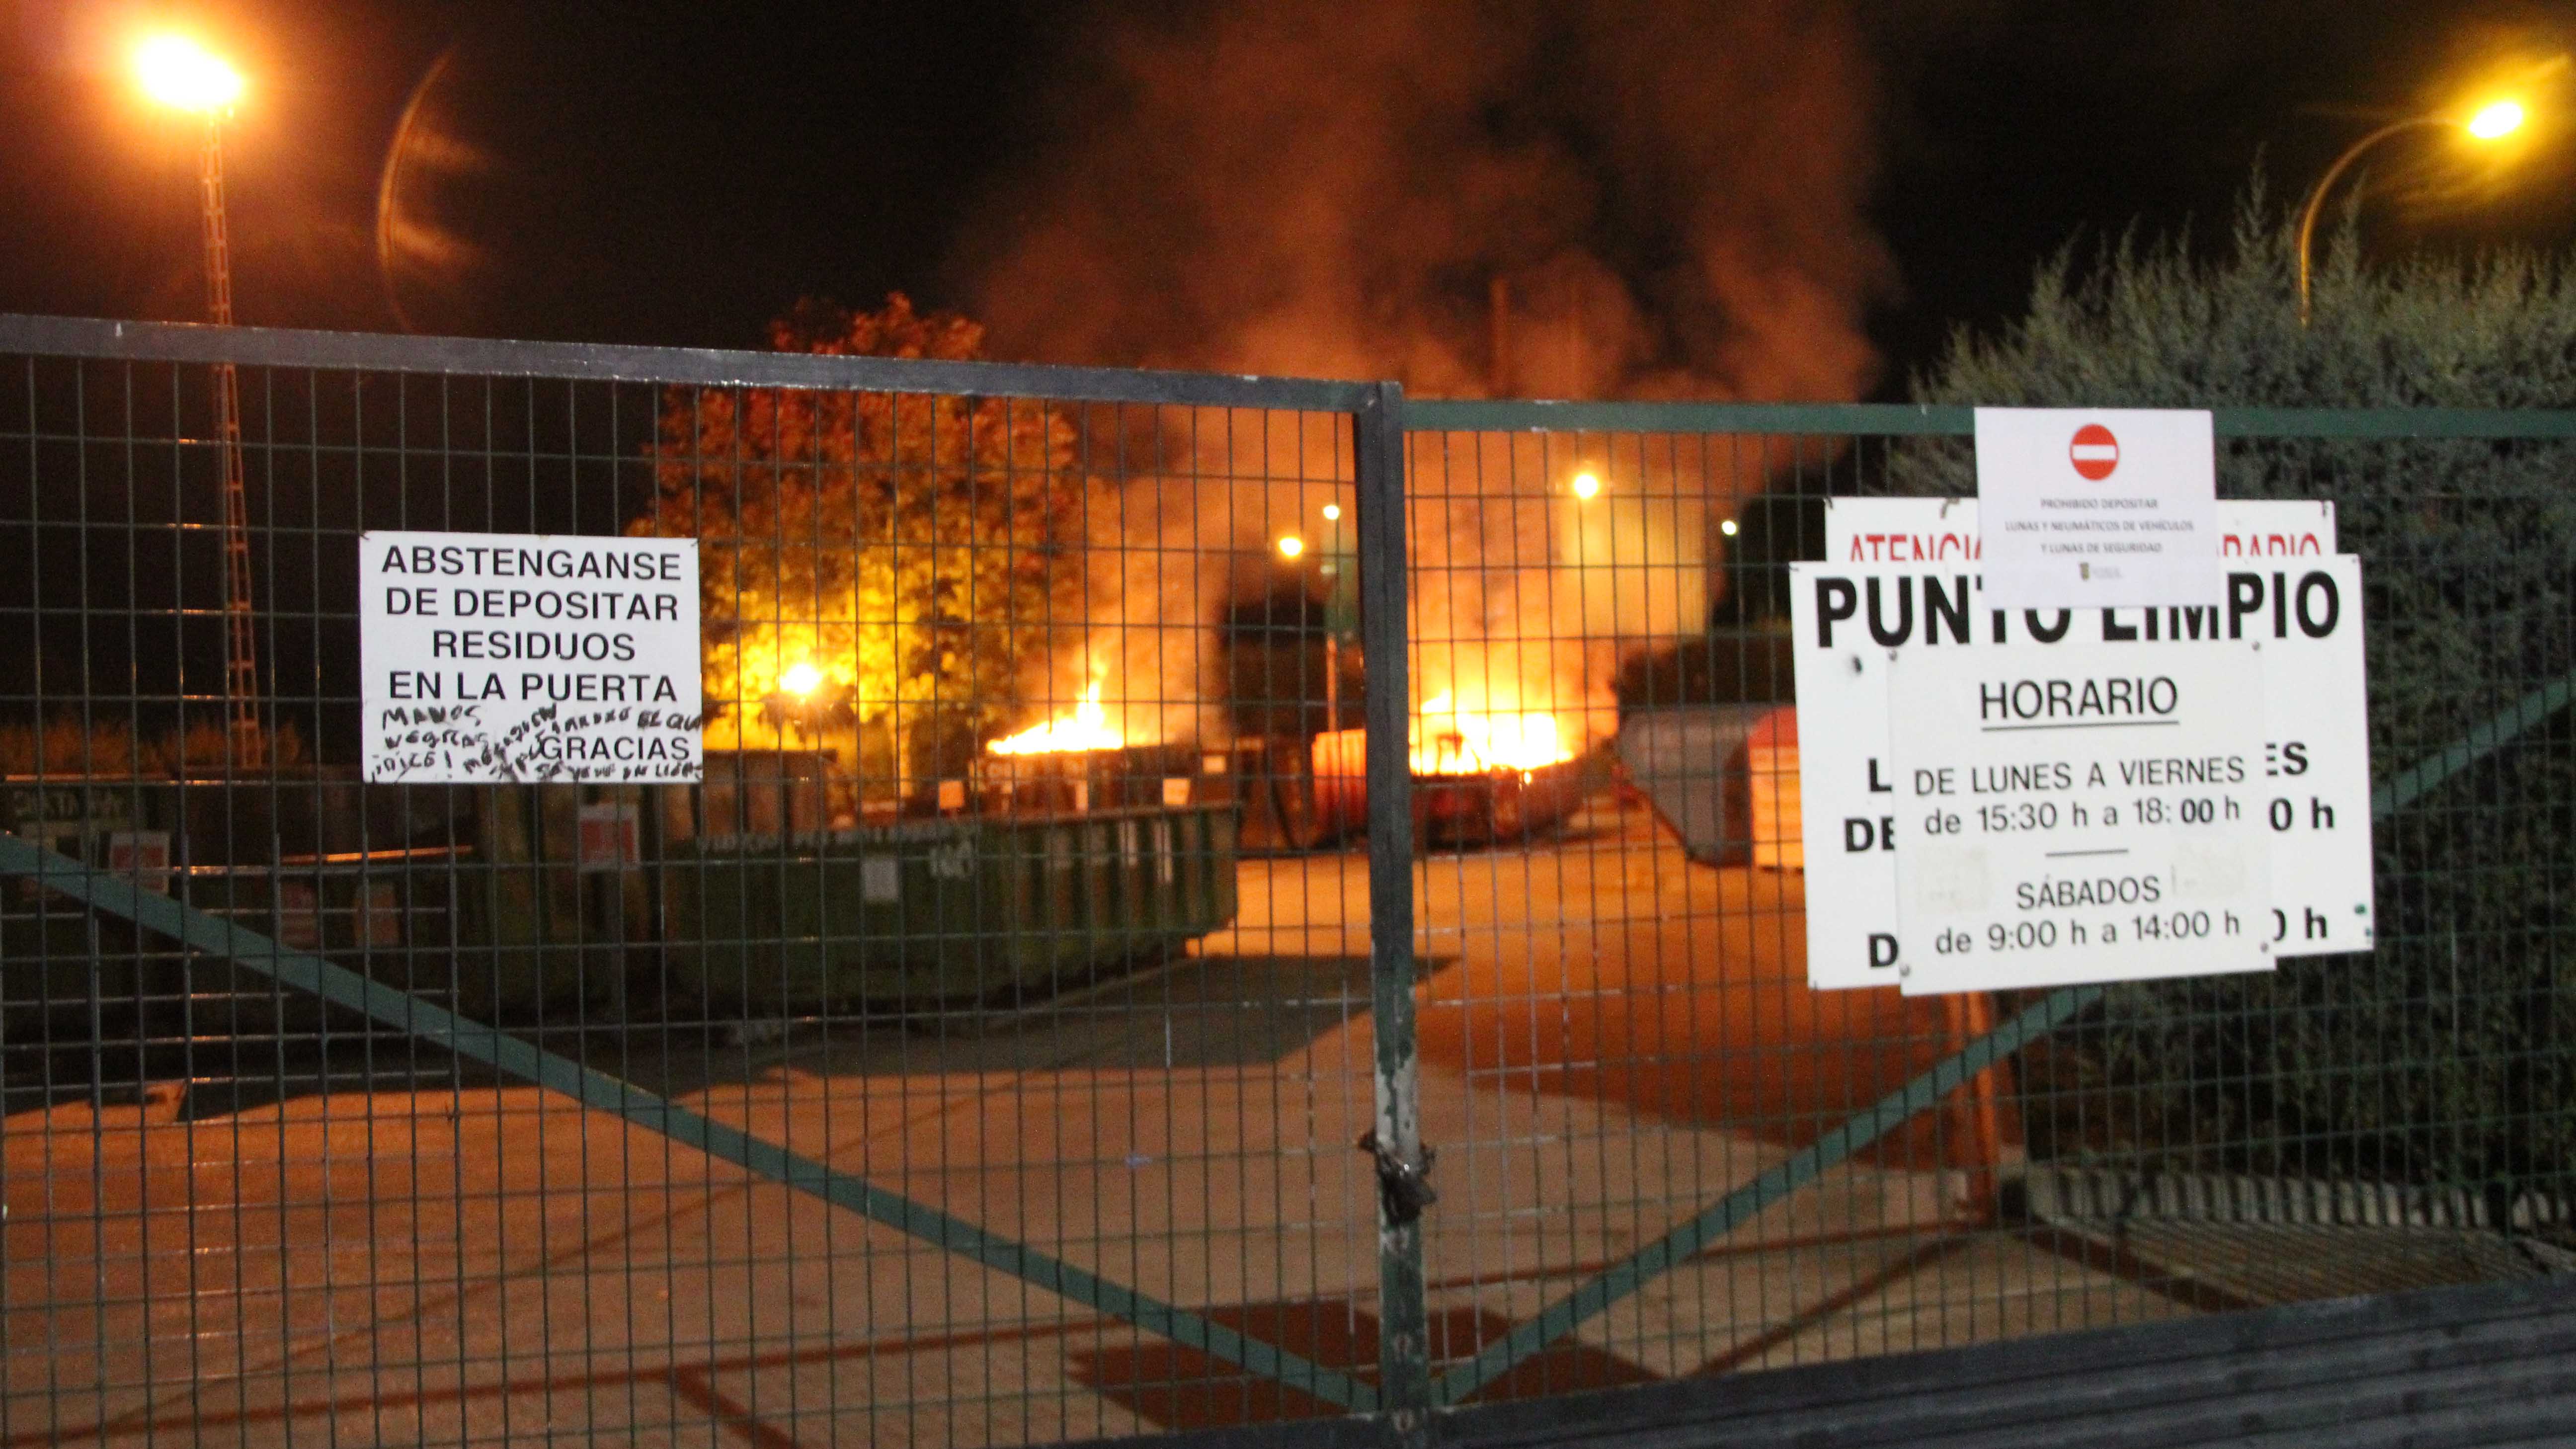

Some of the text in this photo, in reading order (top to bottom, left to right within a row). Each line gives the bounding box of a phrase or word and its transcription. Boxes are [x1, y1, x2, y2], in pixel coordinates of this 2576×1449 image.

[2040, 497, 2159, 510] PROHIBIDO DEPOSITAR
[2005, 519, 2039, 531] LUNAS
[2042, 520, 2048, 530] Y
[2123, 520, 2136, 531] DE
[382, 545, 681, 580] ABSTENGANSE
[2041, 541, 2164, 554] Y LUNAS DE SEGURIDAD
[386, 587, 677, 621] DE DEPOSITAR
[433, 630, 635, 661] RESIDUOS
[390, 671, 677, 703] EN LA PUERTA
[1981, 676, 2177, 720] HORARIO
[540, 734, 691, 761] GRACIAS
[1915, 757, 2244, 796] DE LUNES A VIERNES
[1926, 809, 1960, 835] de
[1980, 803, 2057, 831] 15:30
[2073, 803, 2087, 826] h
[2104, 807, 2117, 825] a
[2225, 796, 2239, 819] h
[2017, 877, 2160, 909] SÁBADOS
[1936, 912, 2239, 954] de 9:00 h a 14:00 h
